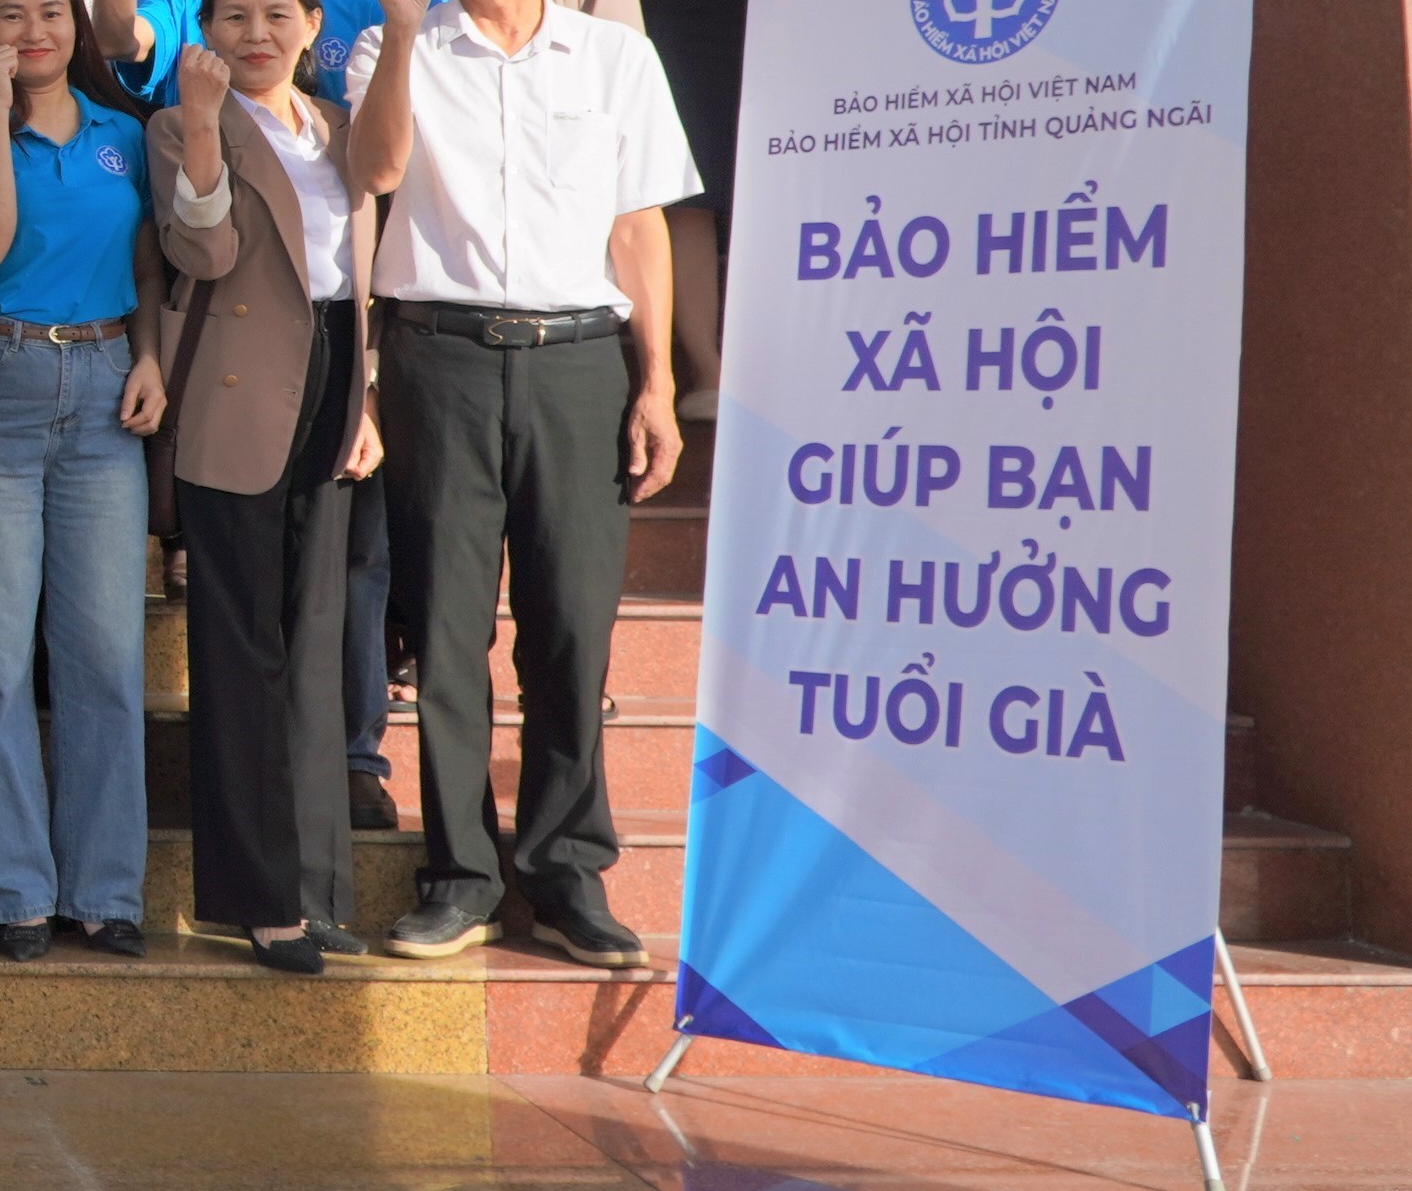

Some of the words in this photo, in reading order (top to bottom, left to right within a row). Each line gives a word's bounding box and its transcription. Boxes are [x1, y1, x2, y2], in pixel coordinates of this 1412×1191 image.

[833, 91, 878, 115] BẢO
[886, 85, 938, 111] HIỂM
[945, 84, 973, 106] XÃ
[982, 80, 1021, 105] HỘI
[1028, 76, 1078, 101] VIỆT
[1085, 72, 1137, 93] NAM
[953, 45, 977, 61] XÃ
[767, 127, 815, 156] BẢO
[824, 122, 880, 152] HIỂM
[889, 122, 919, 148] XÃ
[928, 119, 970, 148] HỘI
[979, 113, 1036, 141] TỈNH
[1045, 106, 1137, 138] QUẢNG
[1146, 101, 1211, 127] NGÃI
[797, 195, 949, 281] BẢO
[976, 180, 1168, 275] HIỂM
[841, 311, 941, 391] XÃ
[965, 308, 1101, 409] HỘI
[788, 427, 961, 507] GIÚP
[987, 446, 1151, 530] BẠN
[756, 555, 861, 620] AN
[886, 538, 1172, 637] HƯỞNG
[789, 652, 963, 748] TUỔI
[989, 671, 1125, 762] GIÀ
